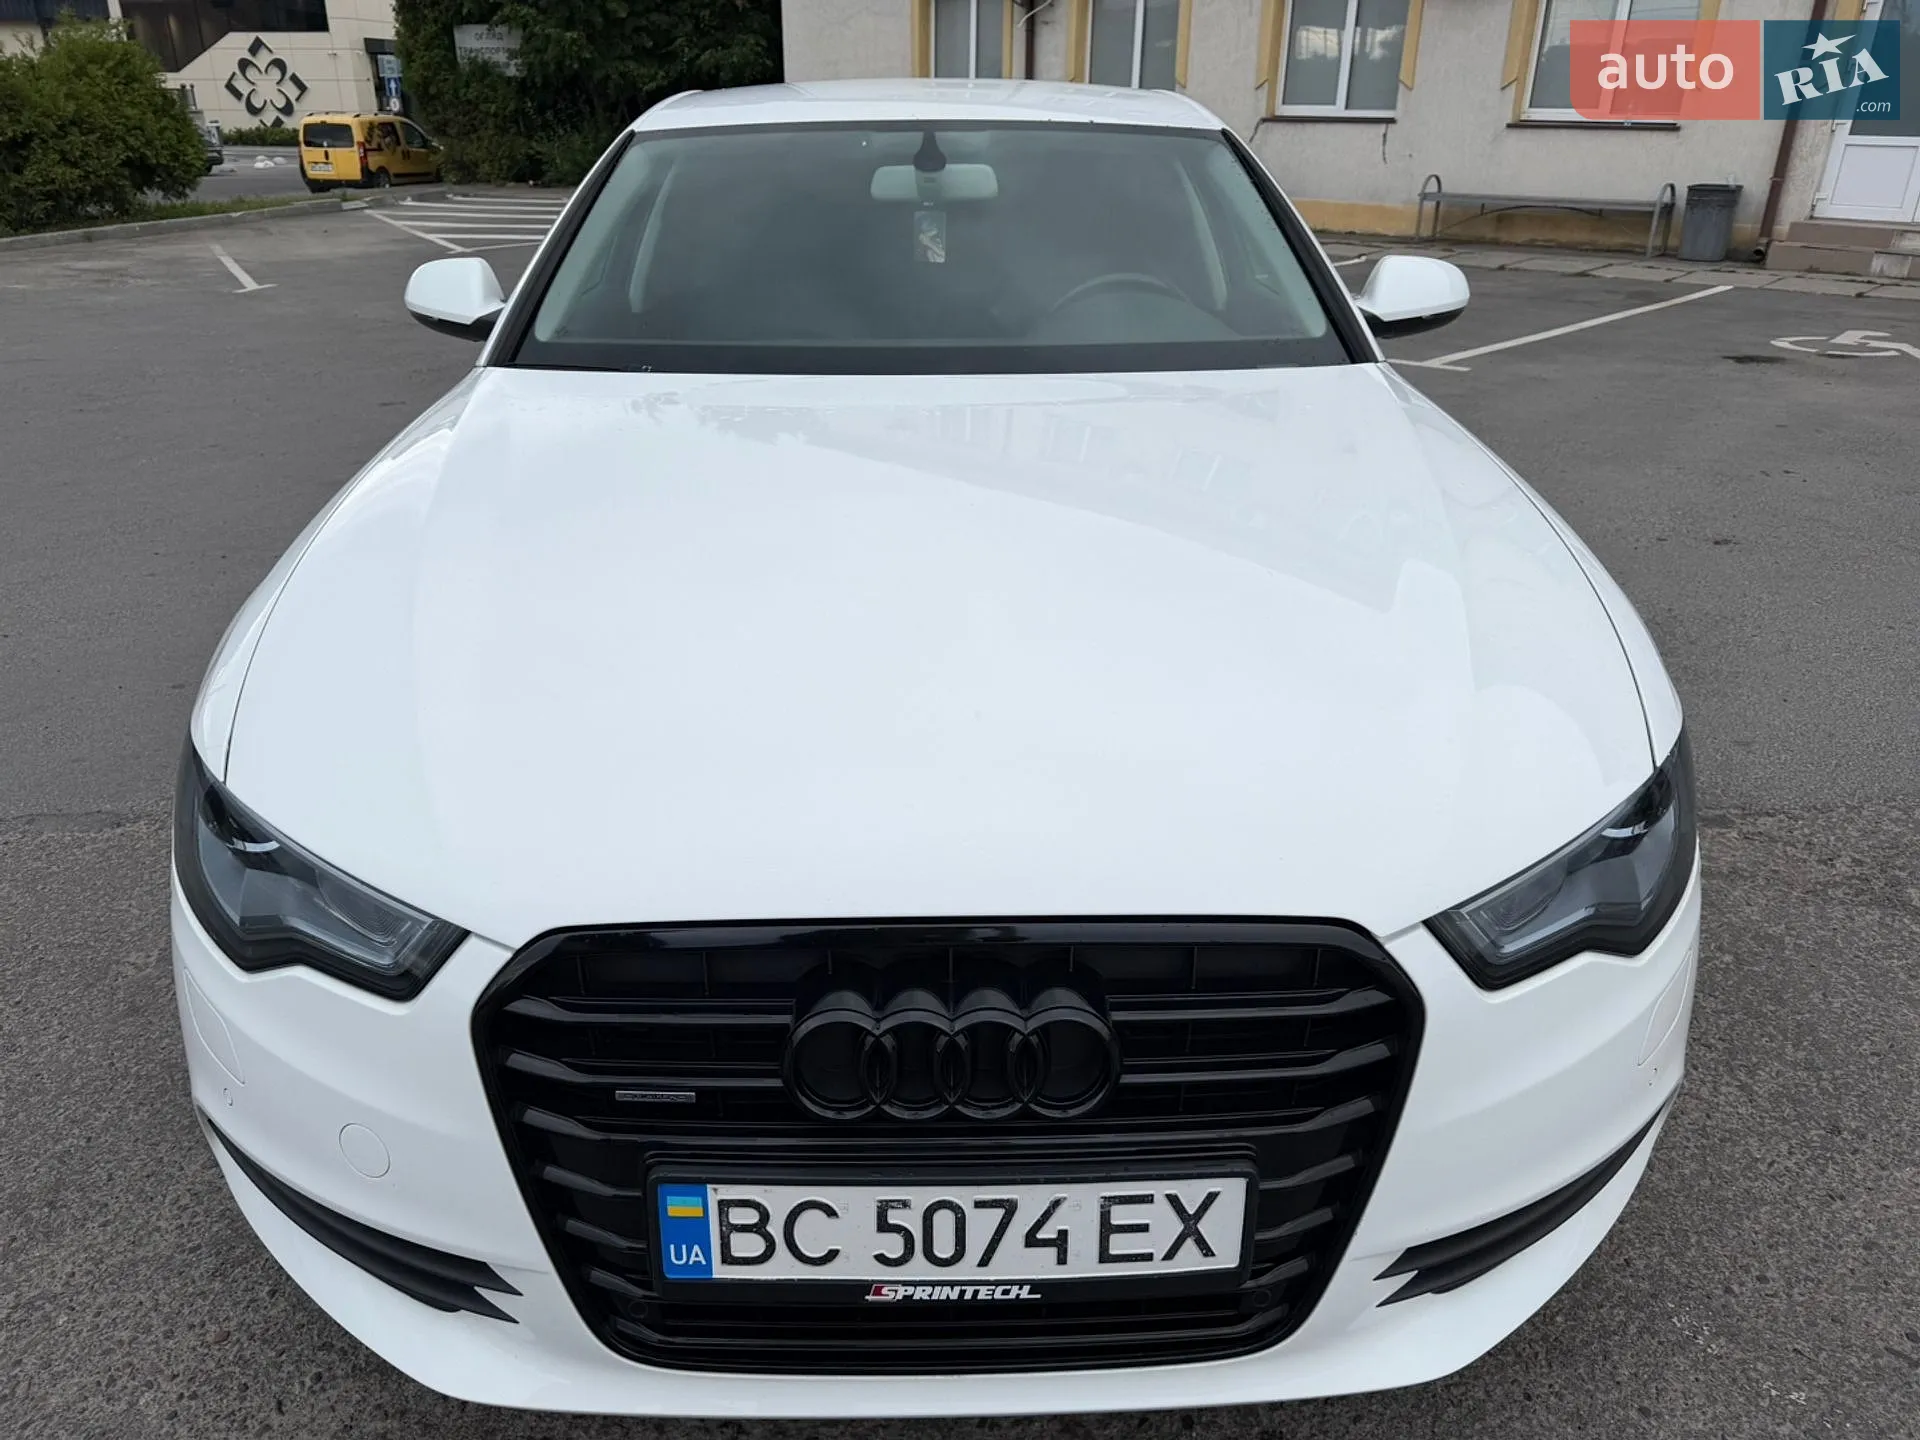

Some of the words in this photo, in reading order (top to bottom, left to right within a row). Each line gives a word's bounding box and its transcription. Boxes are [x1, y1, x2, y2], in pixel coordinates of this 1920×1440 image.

[717, 1198, 841, 1267] BC
[873, 1197, 1069, 1268] 5074
[1098, 1190, 1222, 1265] EX
[670, 1244, 706, 1266] UA
[865, 1284, 1042, 1302] SPRINTECH
